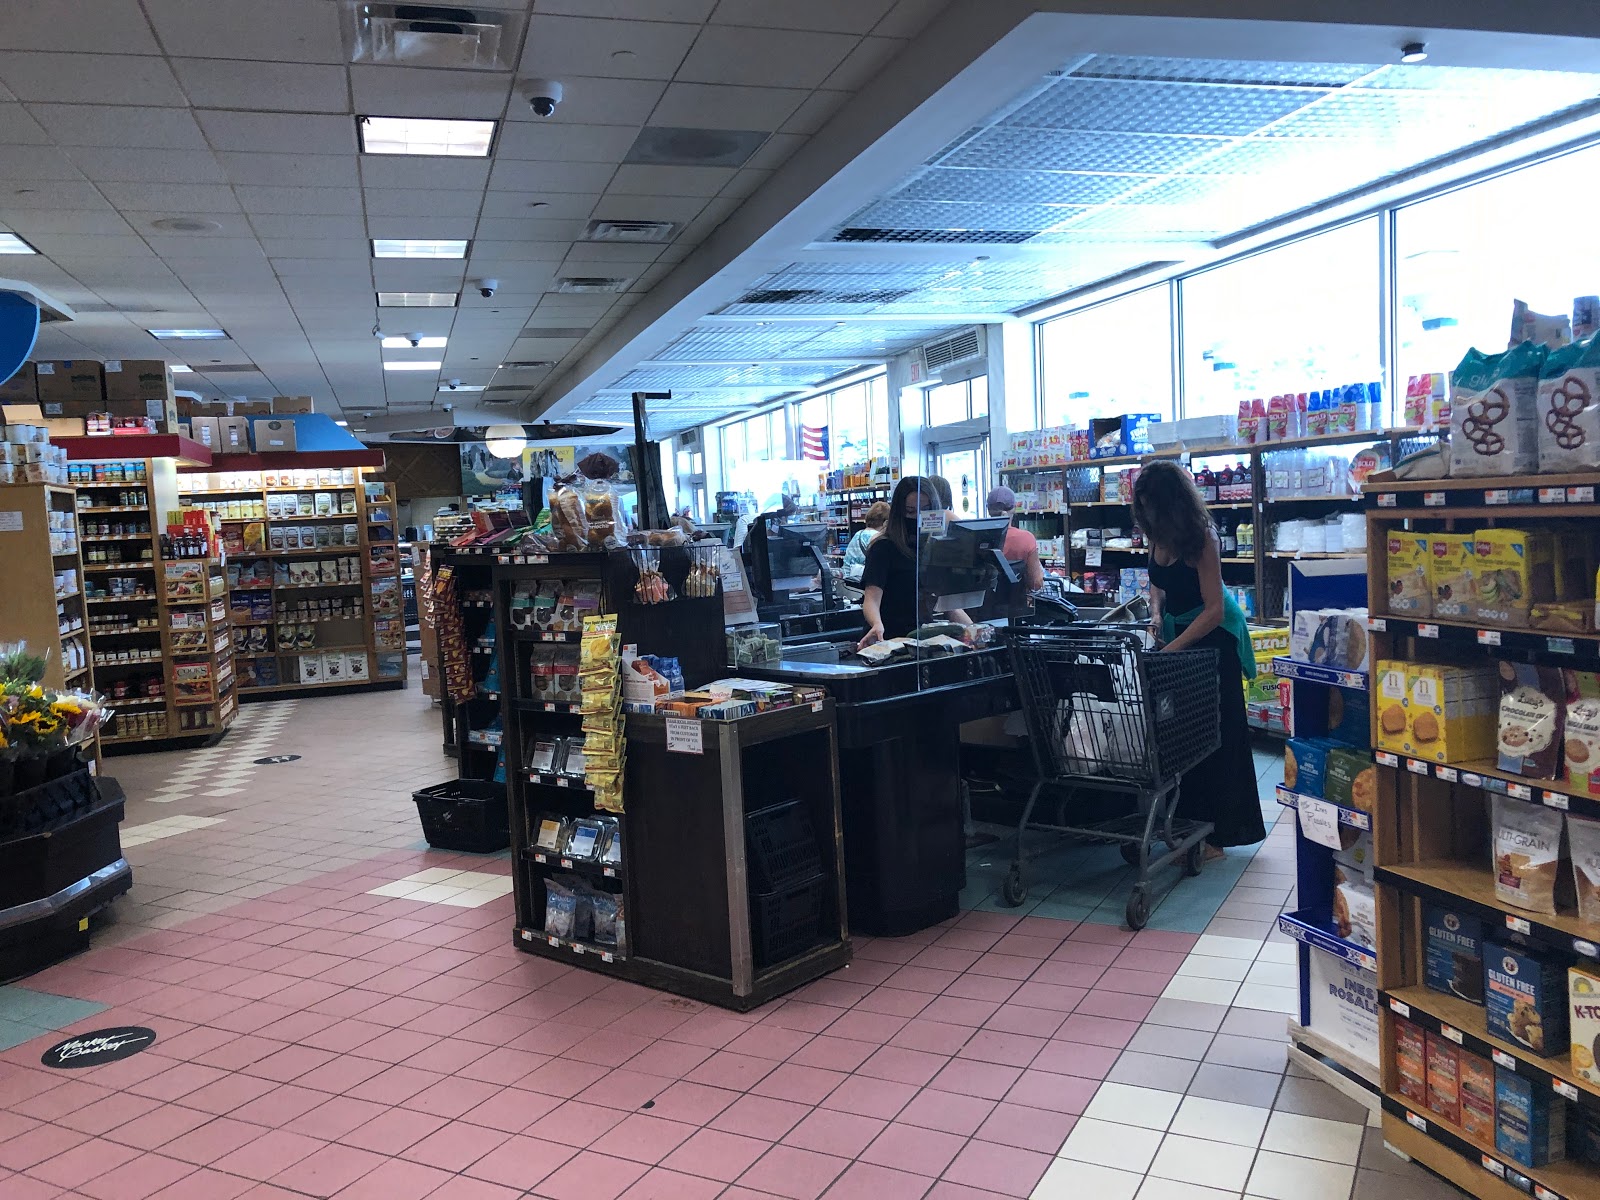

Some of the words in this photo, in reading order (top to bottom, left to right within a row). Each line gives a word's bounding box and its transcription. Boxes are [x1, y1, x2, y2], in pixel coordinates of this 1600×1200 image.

[1269, 413, 1286, 421] SOLO
[1308, 413, 1326, 422] SOLO
[1255, 638, 1288, 650] FUZE
[1256, 663, 1274, 674] FU
[1262, 684, 1280, 692] FUSIO
[1498, 831, 1550, 851] ULTI-GRAIN
[1429, 926, 1456, 942] GLUTEN
[1457, 934, 1476, 948] FREE
[1344, 978, 1374, 1000] INES
[1488, 968, 1516, 988] GLUTEN
[1516, 980, 1535, 996] FREE
[1330, 984, 1378, 1016] ROSALE
[1574, 1005, 1600, 1019] K-TO
[56, 1032, 134, 1052] Market
[58, 1036, 148, 1062] Basket
